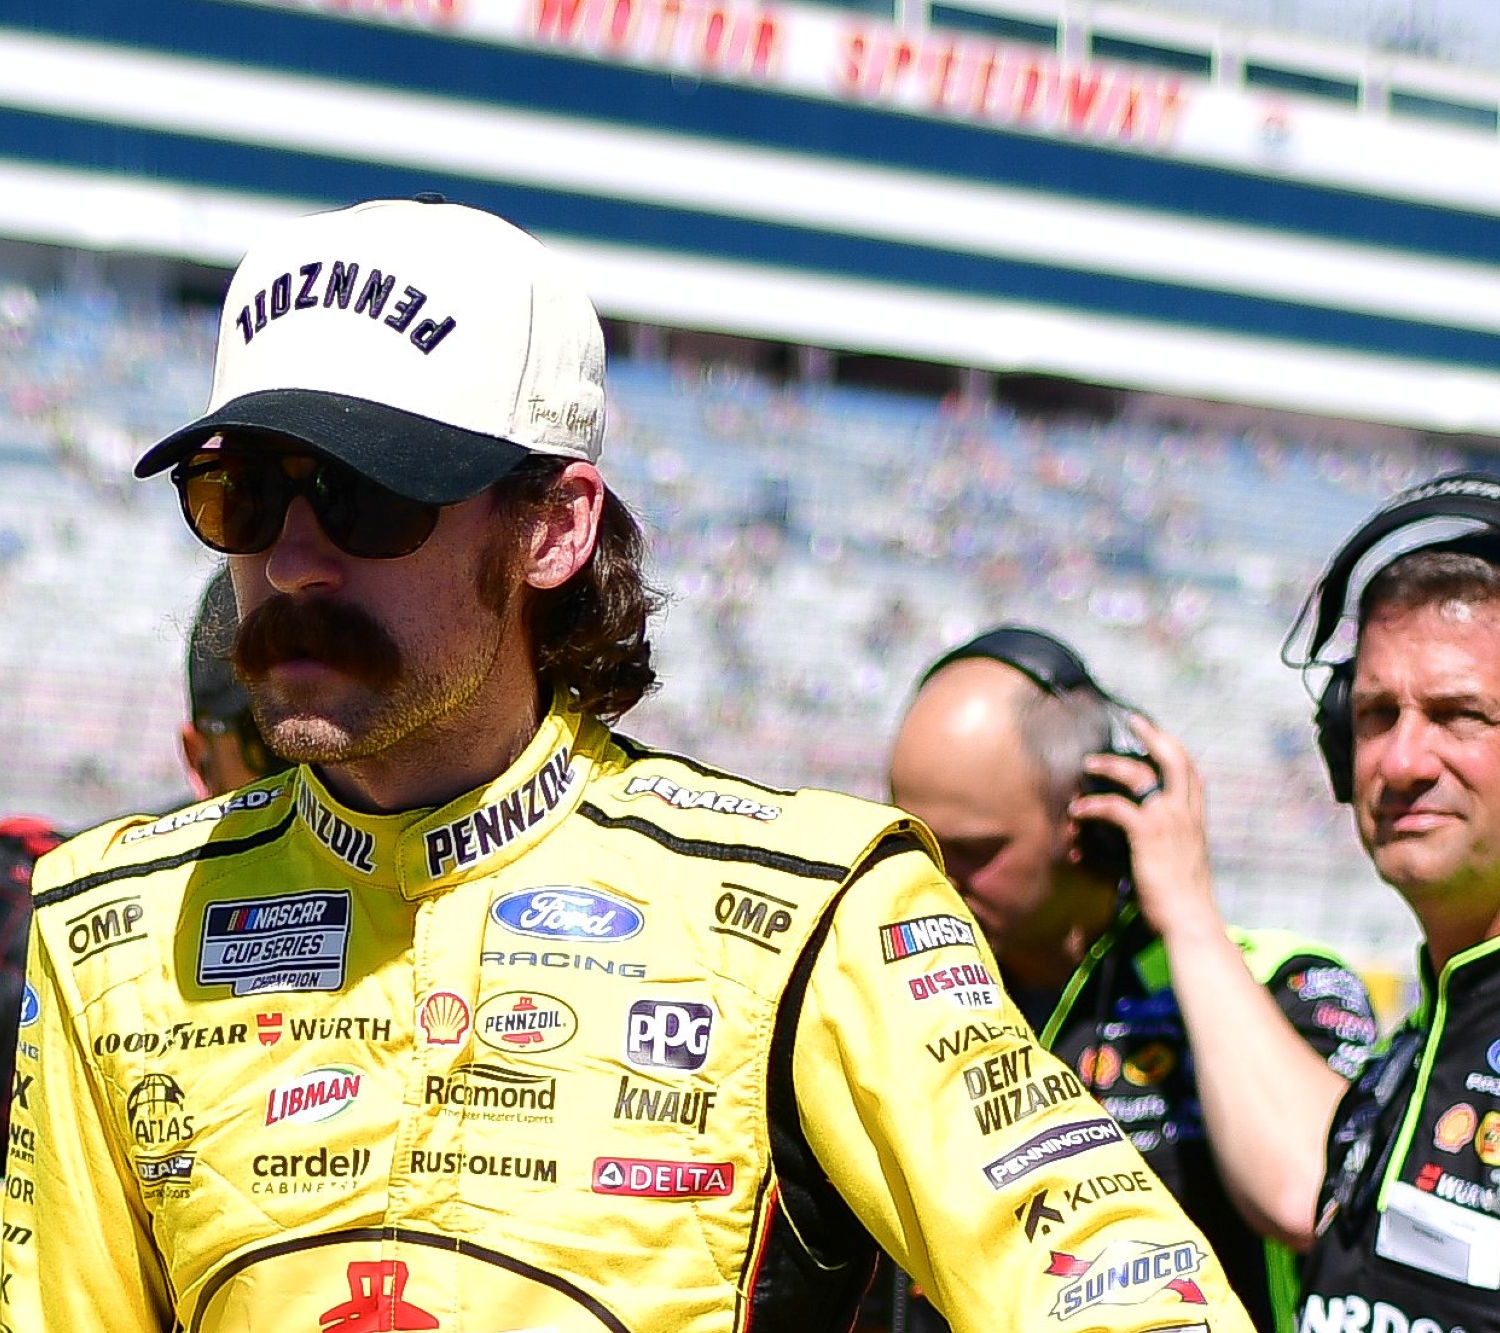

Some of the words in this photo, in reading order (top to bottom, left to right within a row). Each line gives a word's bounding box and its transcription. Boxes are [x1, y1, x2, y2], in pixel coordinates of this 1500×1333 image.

[836, 32, 1190, 150] SPEEDWAY
[236, 261, 457, 354] PENNZOIL
[625, 776, 783, 822] MENARDS
[69, 905, 145, 953] OMP
[253, 900, 328, 930] NASCAR
[519, 890, 616, 938] Ford
[714, 891, 794, 940] OMP
[221, 942, 262, 965] CUP
[261, 934, 324, 960] SERIES
[480, 951, 648, 980] RACING
[908, 963, 998, 1001] DISCOU
[953, 990, 994, 1008] TIRE
[290, 1016, 392, 1042] WÜRTH
[485, 1010, 564, 1033] PENNZOIL
[630, 1003, 713, 1064] PPG
[963, 1044, 1035, 1100] DENT
[264, 1073, 362, 1127] LIBMAN
[613, 1075, 719, 1134] KNAUF
[974, 1067, 1083, 1136] WIZARD
[252, 1146, 371, 1178] cardell
[991, 1121, 1119, 1185] PENNINGTON
[251, 1181, 358, 1195] CABINE
[629, 1164, 730, 1194] DELTA
[1066, 1170, 1154, 1212] KIDDE
[1064, 1246, 1195, 1314] SUNOCO
